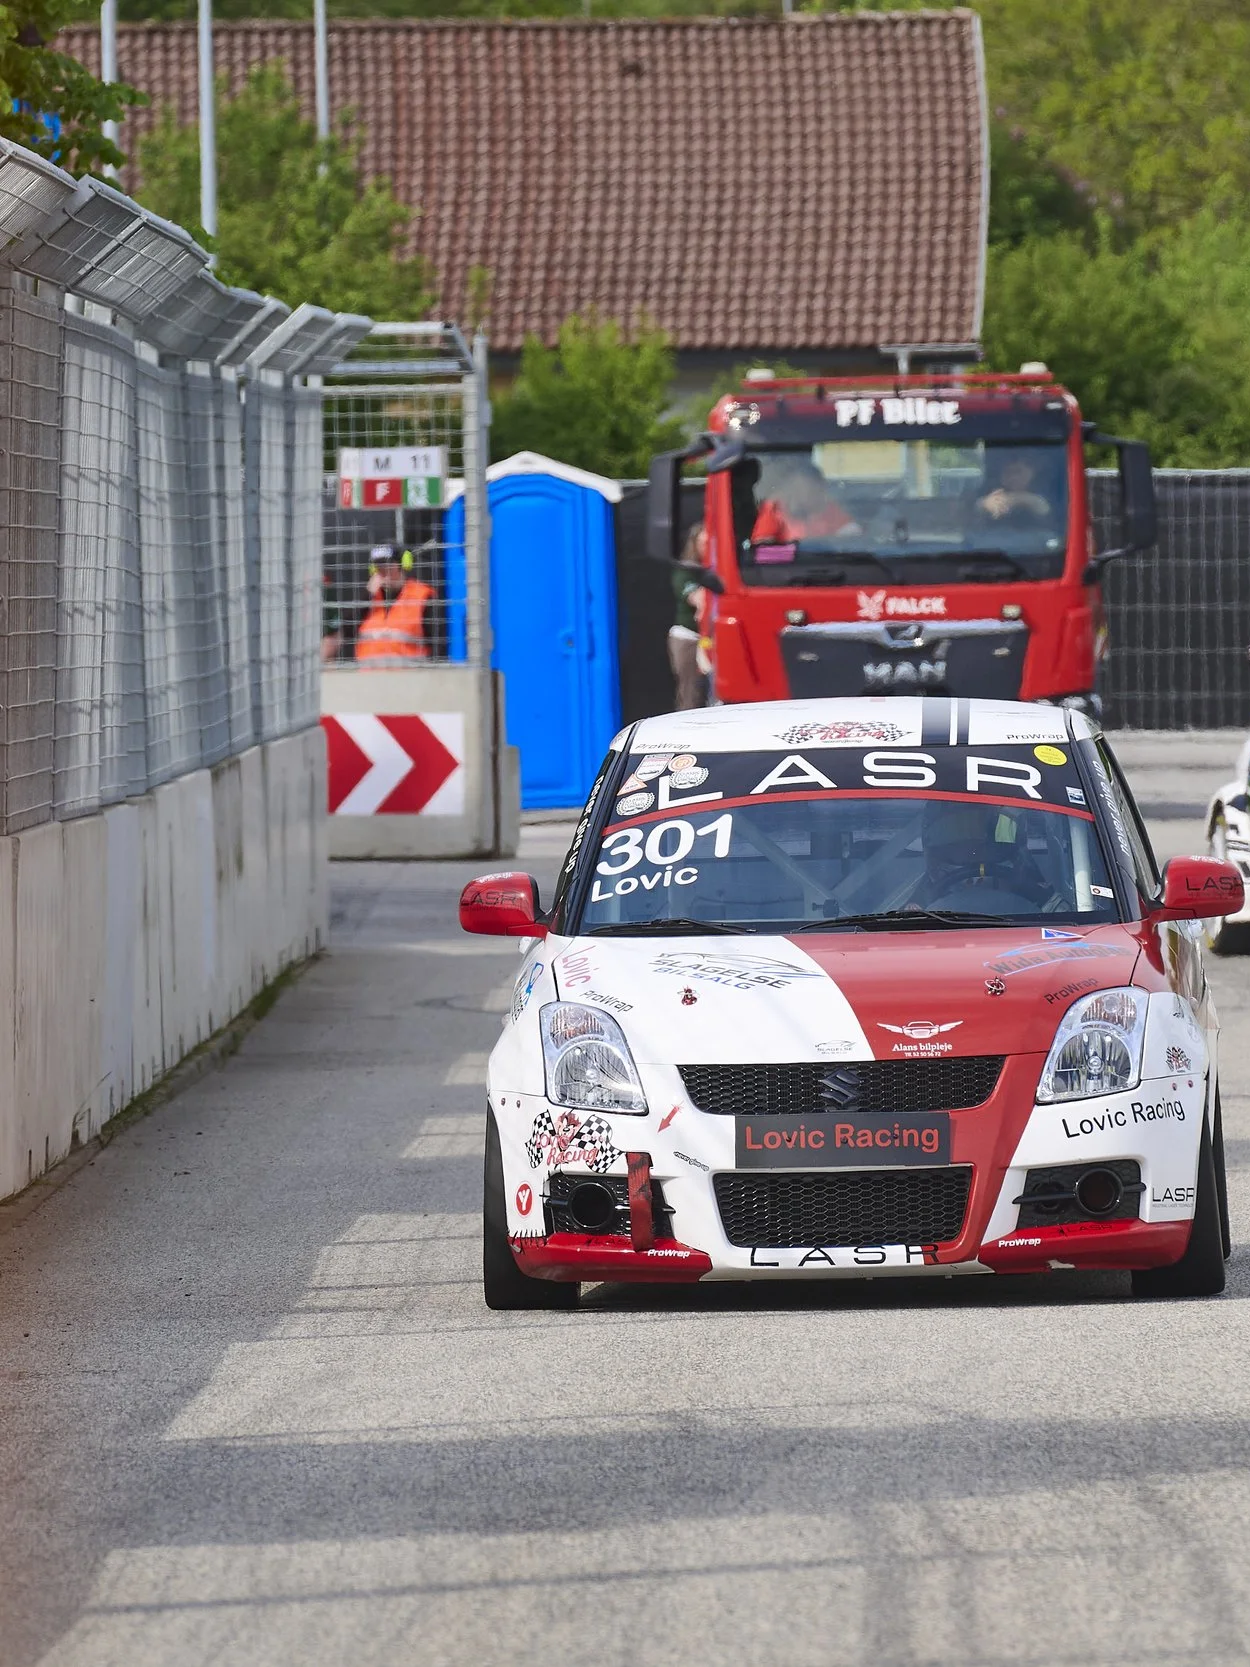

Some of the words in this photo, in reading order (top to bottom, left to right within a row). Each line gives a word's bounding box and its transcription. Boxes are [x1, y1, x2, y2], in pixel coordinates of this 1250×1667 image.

[835, 398, 876, 427] PF
[863, 660, 947, 685] MAN
[635, 743, 691, 751] ProWrap
[1006, 733, 1064, 741] ProWrap
[658, 751, 1042, 810] LASR
[1092, 760, 1107, 780] up
[596, 813, 733, 876] 301
[1109, 812, 1131, 857] never
[564, 851, 579, 874] up
[590, 865, 699, 903] Lovic
[562, 945, 599, 988] Lovic
[648, 958, 792, 989] SLAGELSE
[653, 967, 756, 990] BILSALG
[580, 990, 634, 1012] ProWrap
[1043, 977, 1099, 1004] ProWrap
[892, 1043, 918, 1052] Alans
[919, 1042, 953, 1053] bilpleje
[1061, 1108, 1127, 1139] Lovic
[1131, 1097, 1186, 1123] Racing
[745, 1124, 825, 1150] Lovic
[835, 1123, 939, 1154] Racing
[647, 1249, 691, 1259] ProWrap
[998, 1237, 1042, 1248] ProWrap
[750, 1244, 940, 1267] LASR
